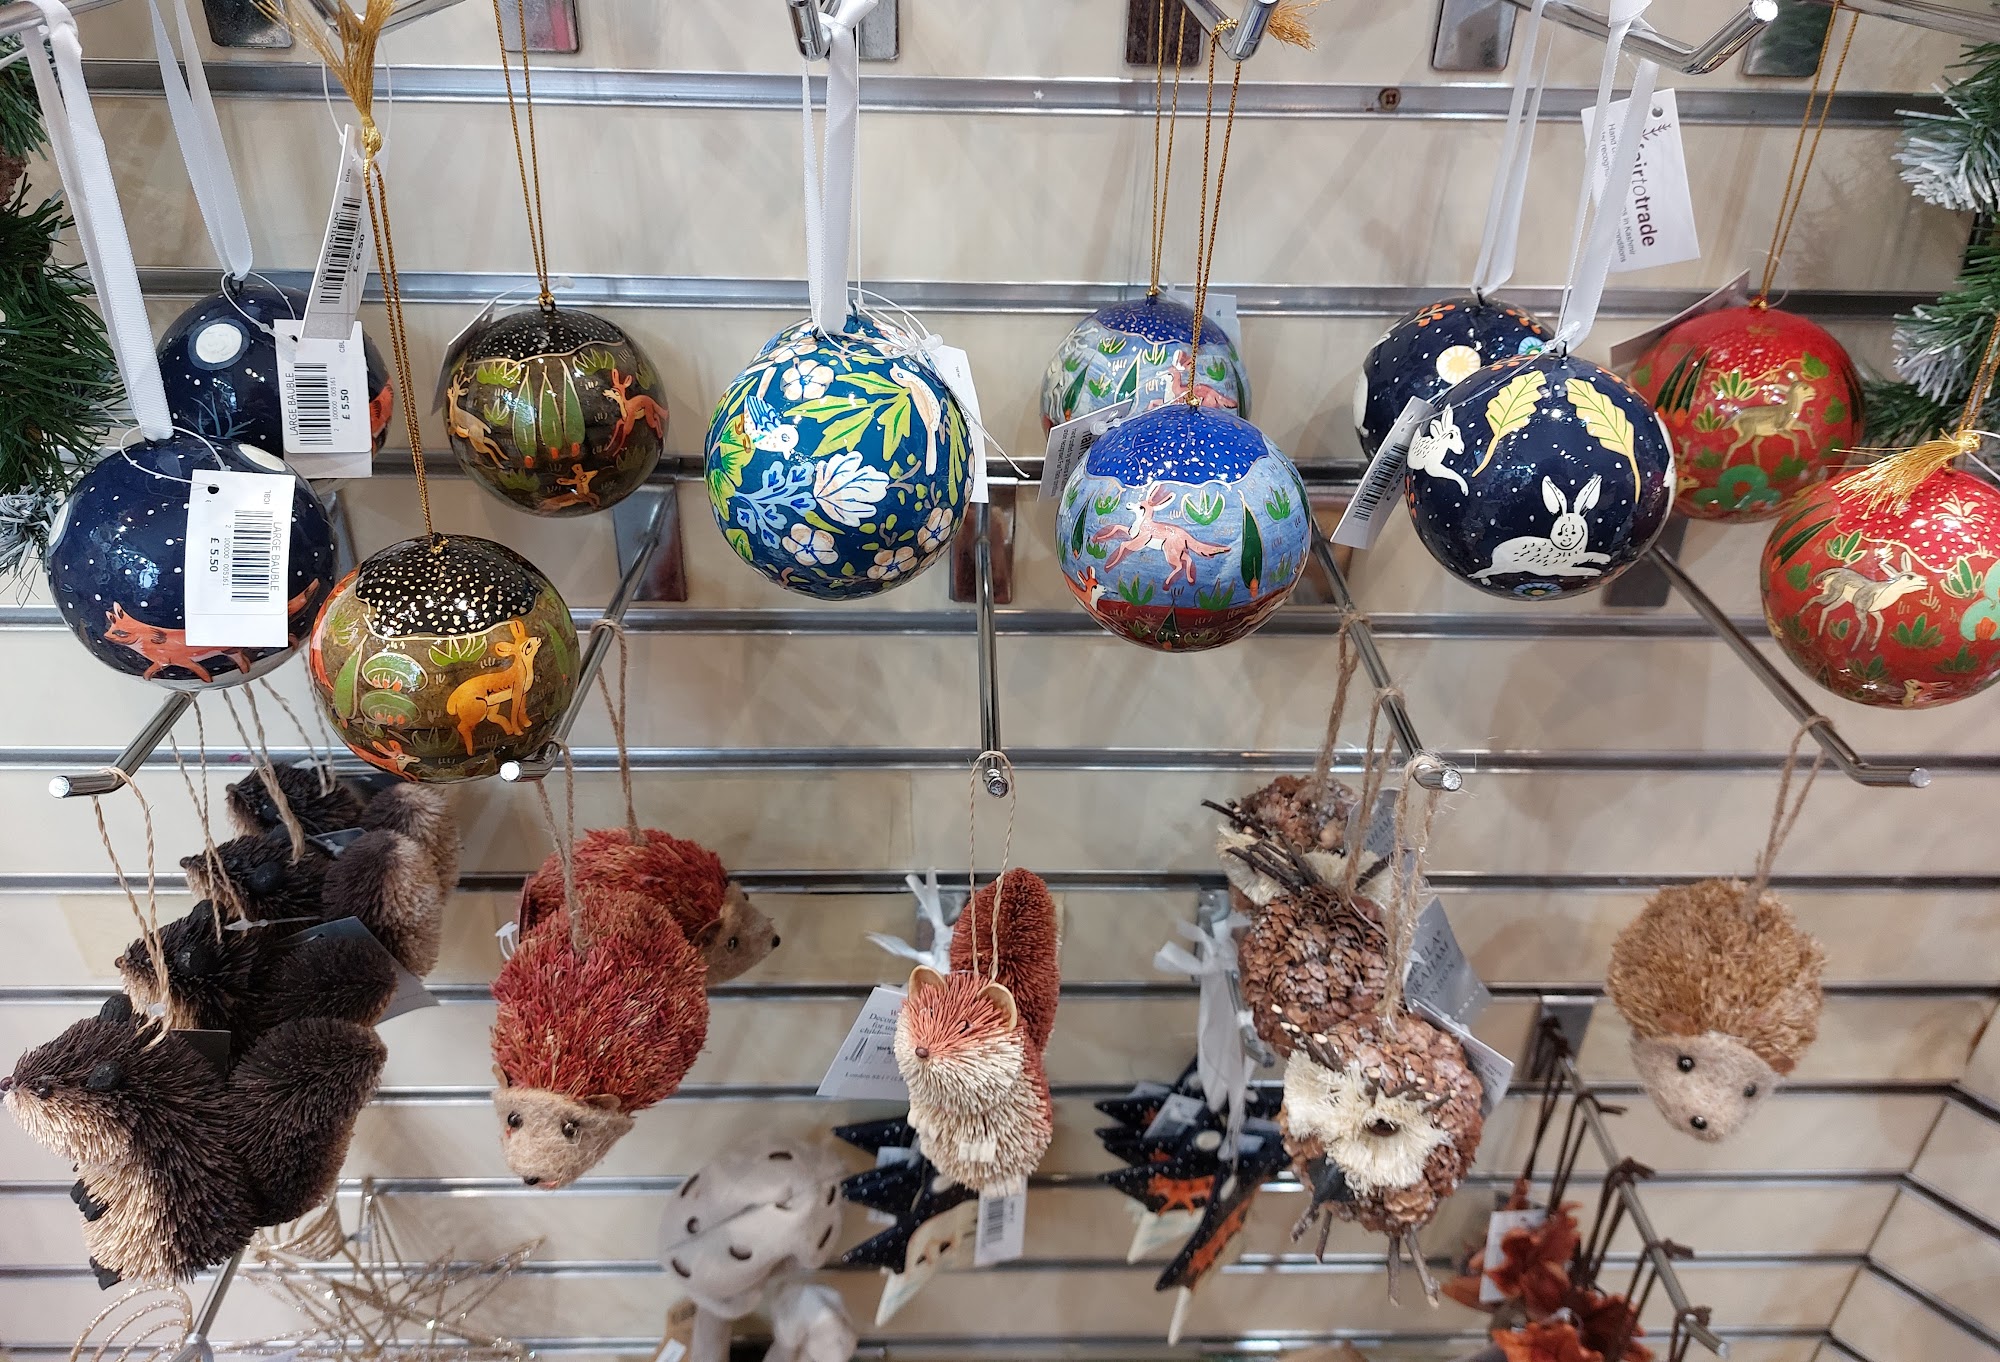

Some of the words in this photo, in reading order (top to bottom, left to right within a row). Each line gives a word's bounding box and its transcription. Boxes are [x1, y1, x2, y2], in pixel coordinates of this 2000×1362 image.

[1632, 144, 1658, 246] irtotrade
[318, 268, 328, 288] LGE
[324, 212, 342, 264] PREMIUM
[356, 234, 365, 260] 6.50
[286, 373, 296, 406] BAUBLE
[340, 389, 350, 410] 5.50
[288, 408, 298, 436] LARGE
[272, 522, 282, 551] LARGE
[210, 549, 218, 572] 5.50
[270, 554, 280, 591] BAUBLE
[869, 1012, 897, 1024] Decora
[872, 1022, 884, 1030] for
